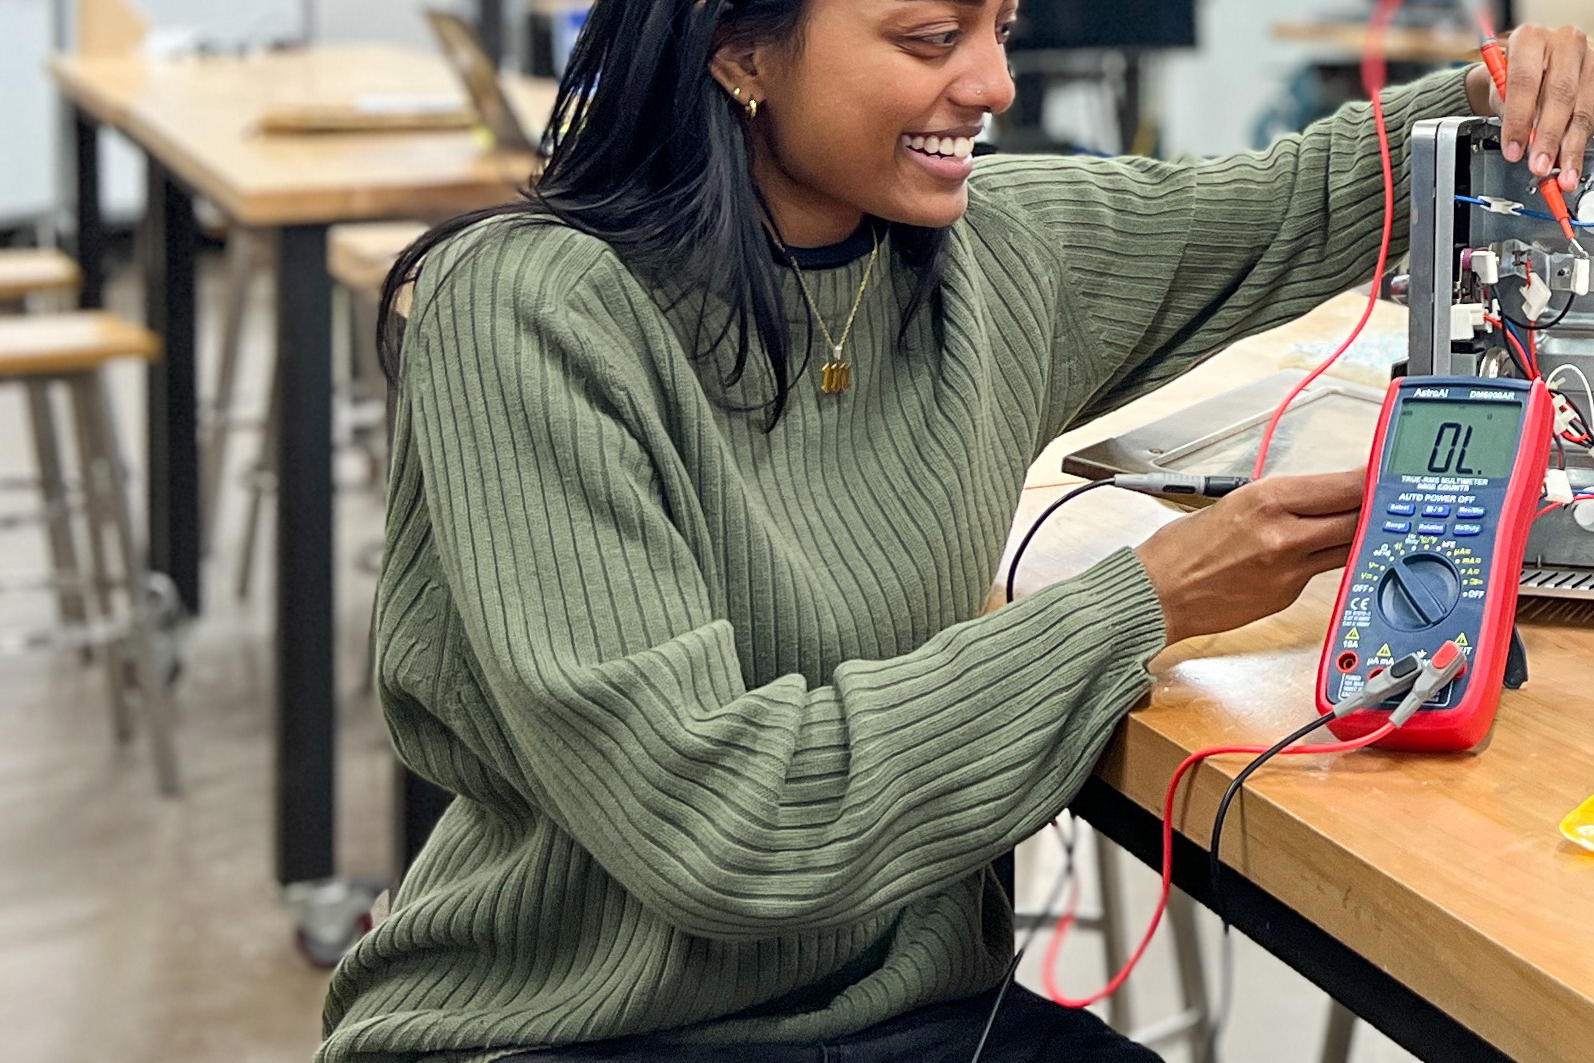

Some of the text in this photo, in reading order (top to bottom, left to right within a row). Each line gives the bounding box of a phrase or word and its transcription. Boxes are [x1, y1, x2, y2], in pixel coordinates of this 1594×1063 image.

[1398, 492, 1476, 504] AUTO POWER OFF
[1352, 584, 1369, 593] OFF
[1468, 590, 1485, 599] OFF
[1350, 597, 1370, 610] CE
